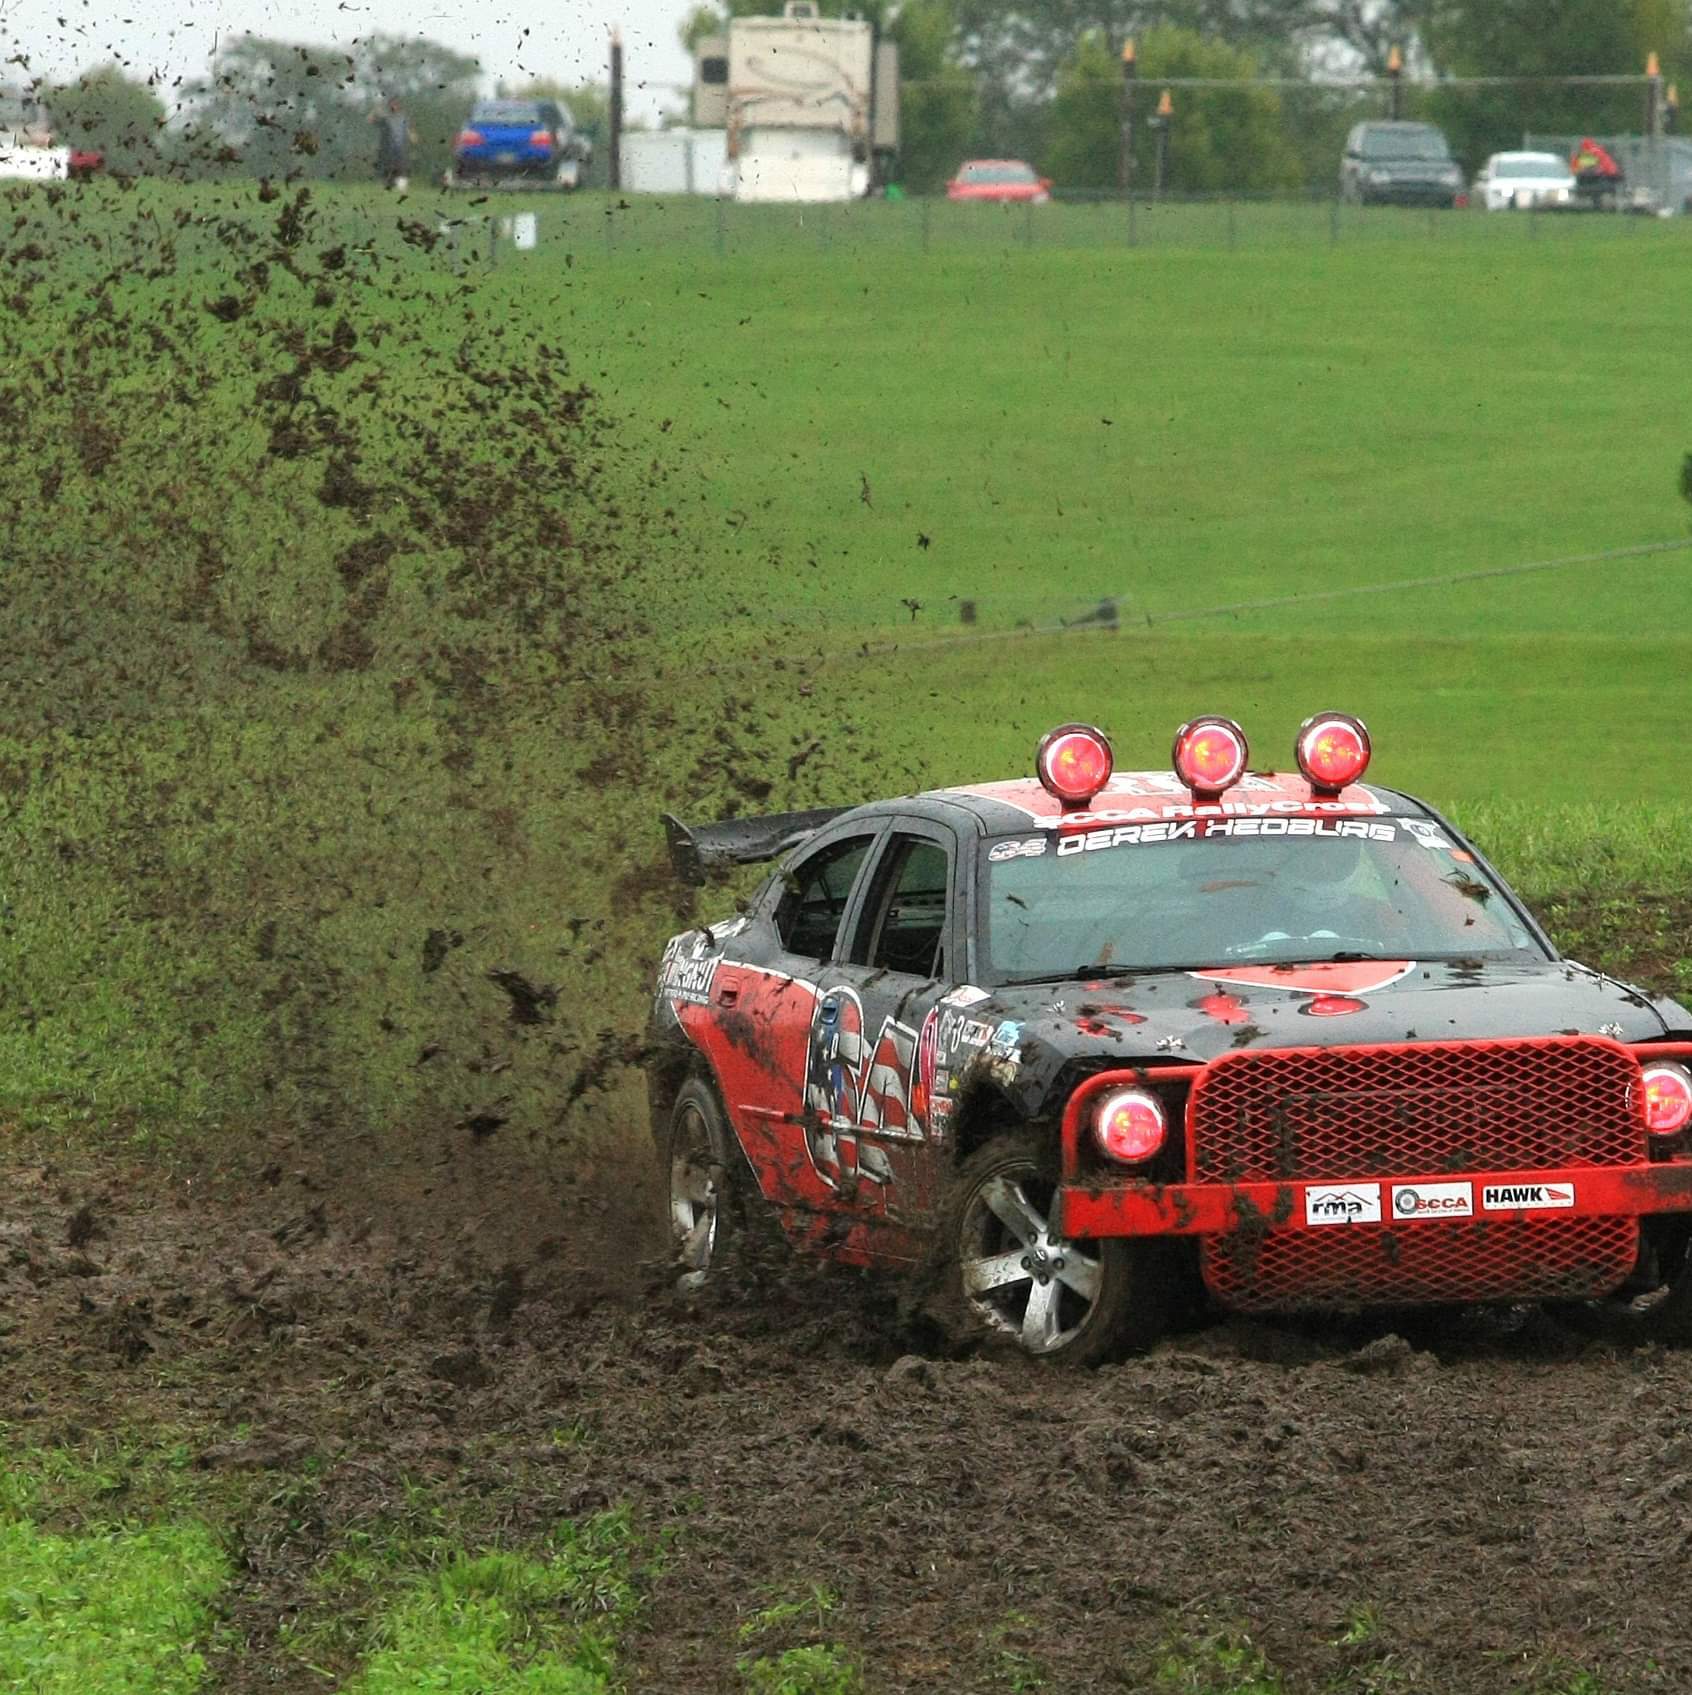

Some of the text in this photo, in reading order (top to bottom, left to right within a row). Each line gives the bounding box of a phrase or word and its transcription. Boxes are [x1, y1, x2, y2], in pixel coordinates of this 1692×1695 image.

[1033, 807, 1161, 829] SCCA
[1056, 820, 1197, 857] DEREK
[1204, 818, 1396, 842] HEDBURG
[1415, 1196, 1468, 1210] SCCA
[1486, 1186, 1543, 1203] HAWK
[1312, 1199, 1362, 1216] rma
